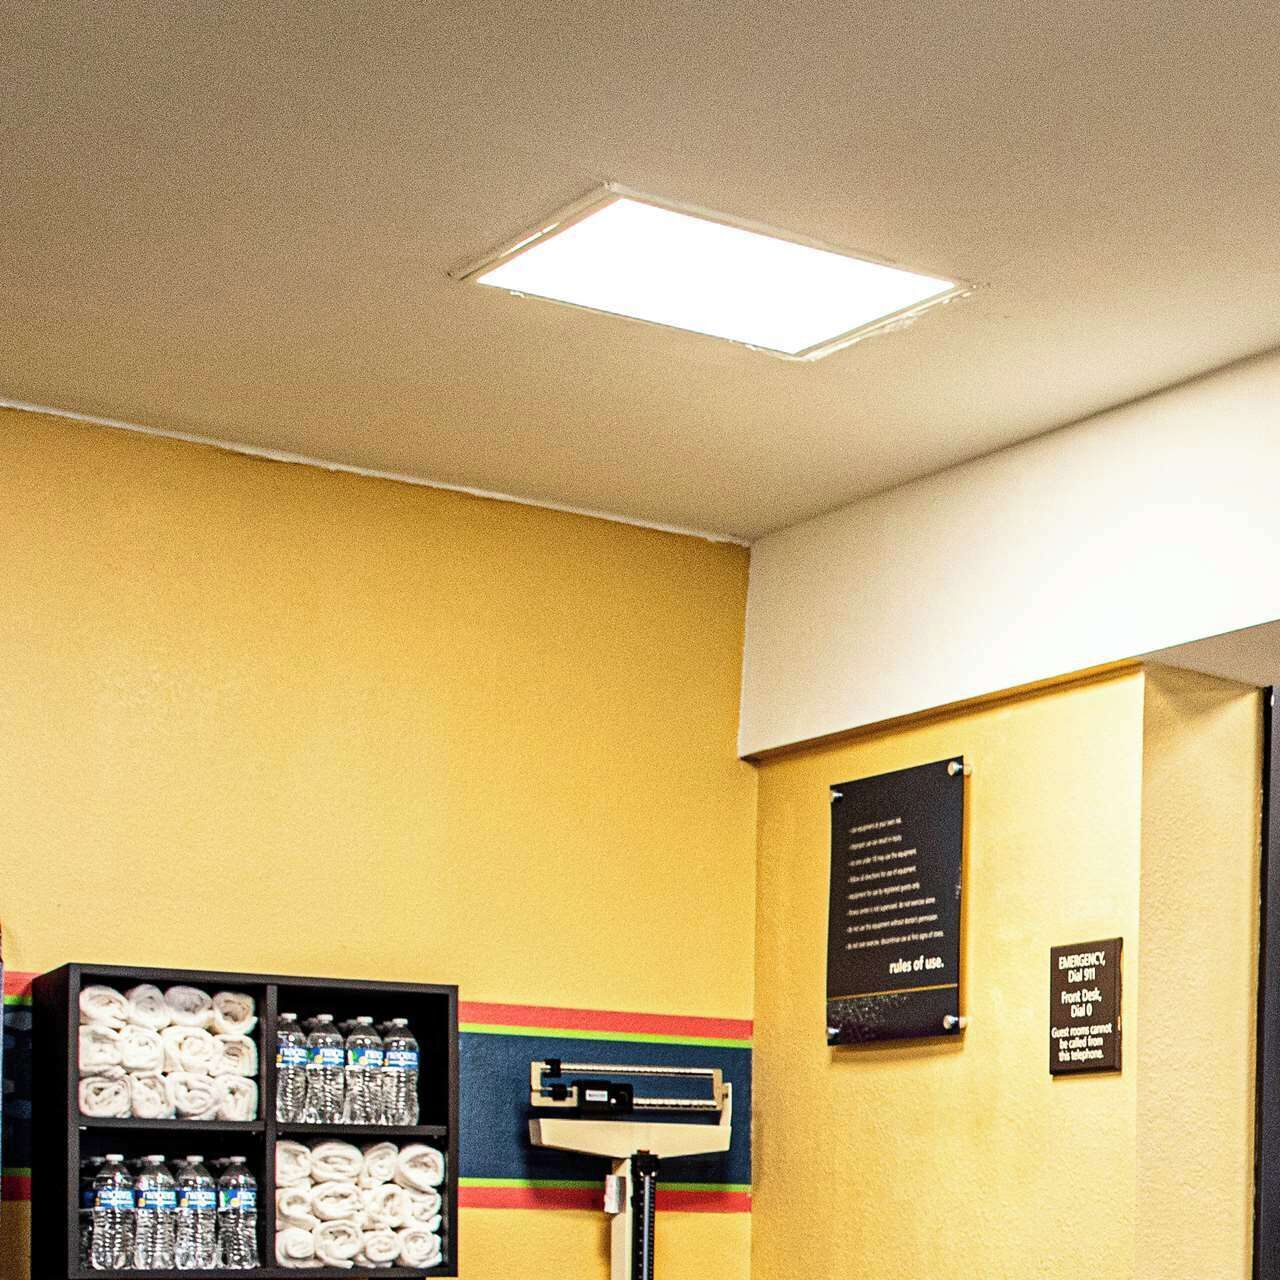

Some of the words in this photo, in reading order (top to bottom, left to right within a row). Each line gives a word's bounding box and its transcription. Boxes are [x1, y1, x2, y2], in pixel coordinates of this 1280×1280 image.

[889, 958, 912, 974] rules
[913, 955, 924, 971] of
[925, 956, 944, 970] use.
[1058, 951, 1106, 970] EMERGENCY,
[1068, 968, 1082, 983] Dial
[1084, 968, 1096, 981] 911
[1061, 990, 1081, 1004] Front
[1082, 987, 1102, 1002] Desk,
[1070, 1004, 1086, 1018] Dial
[1052, 1027, 1070, 1038] Guest
[1070, 1026, 1090, 1036] rooms
[1090, 1023, 1112, 1034] cannot
[1059, 1038, 1068, 1050] be
[1068, 1036, 1087, 1048] called
[1088, 1036, 1104, 1047] from
[1058, 1050, 1070, 1062] this
[1070, 1048, 1104, 1062] telephone.
